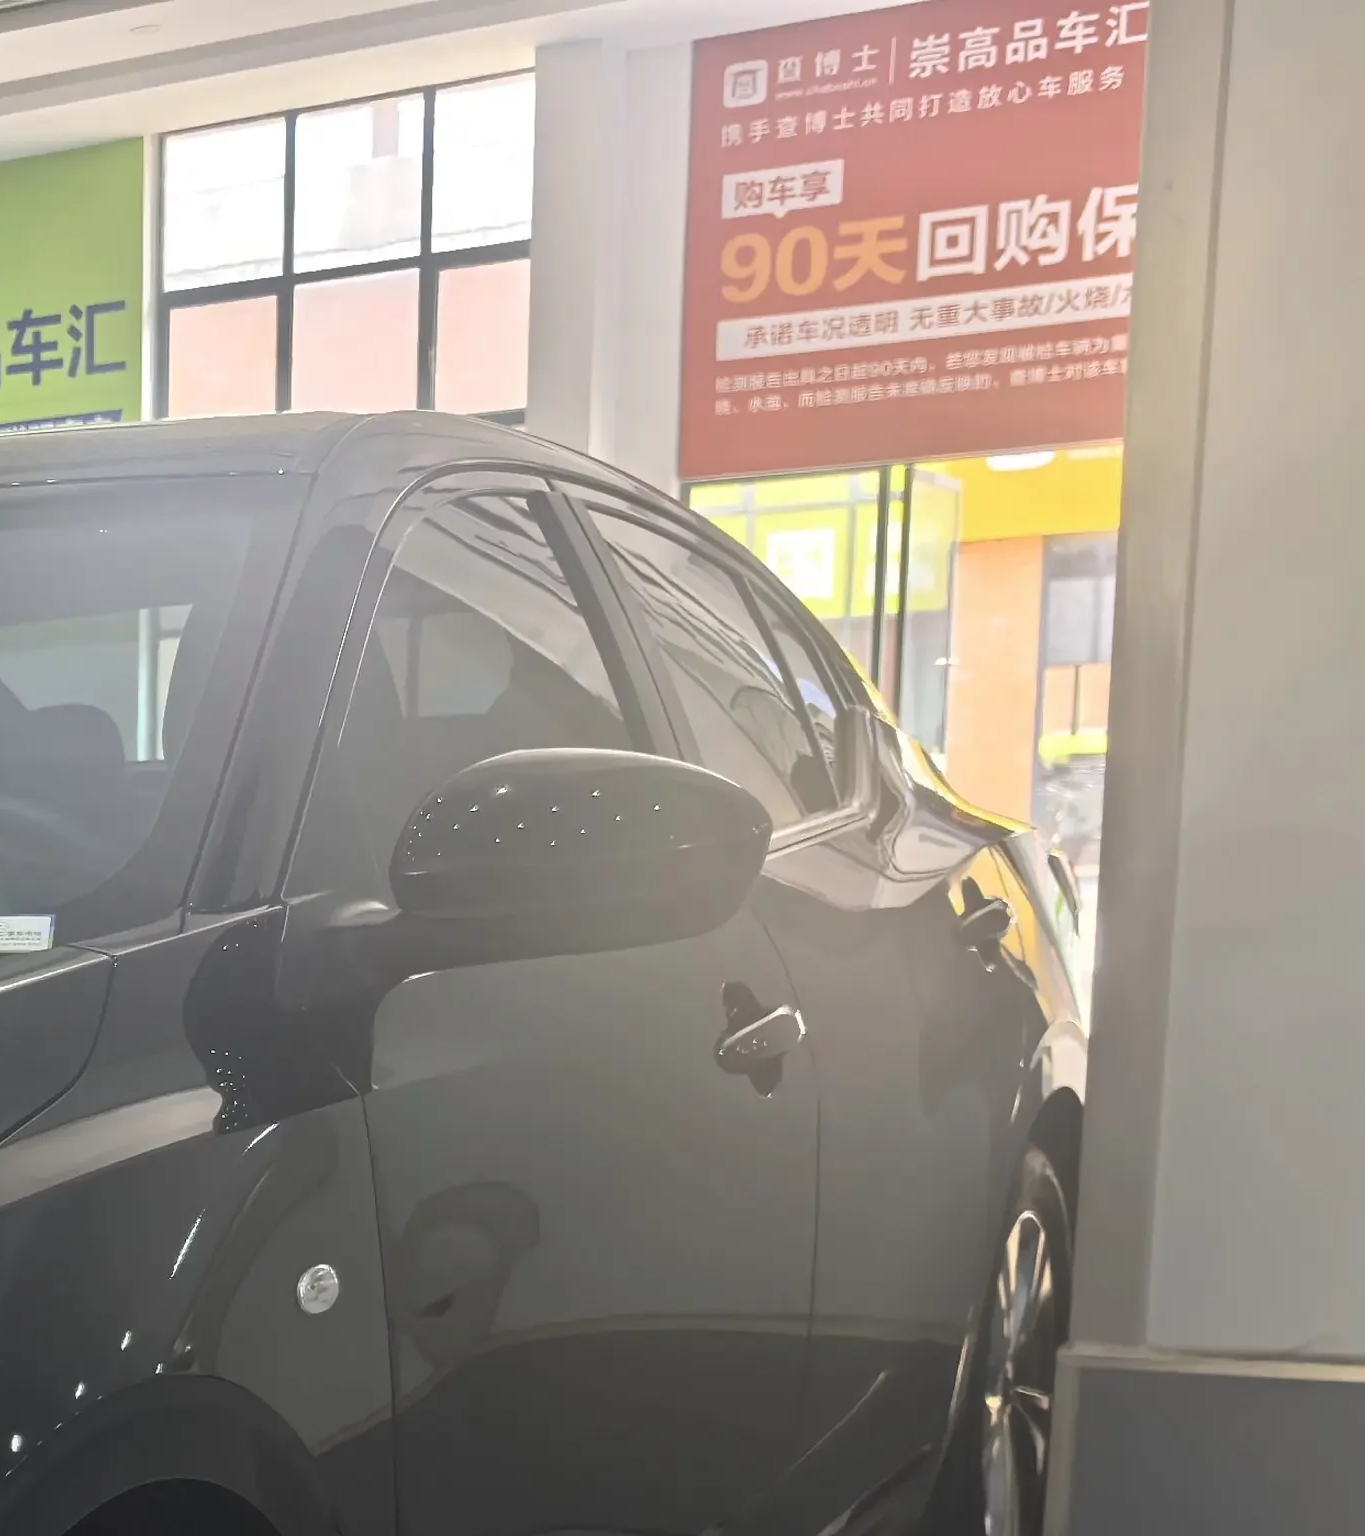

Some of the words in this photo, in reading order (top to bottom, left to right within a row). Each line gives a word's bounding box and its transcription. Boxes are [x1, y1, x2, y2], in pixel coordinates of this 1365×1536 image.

[907, 1, 1150, 79] 崇高品车汇
[734, 169, 832, 211] 购车享
